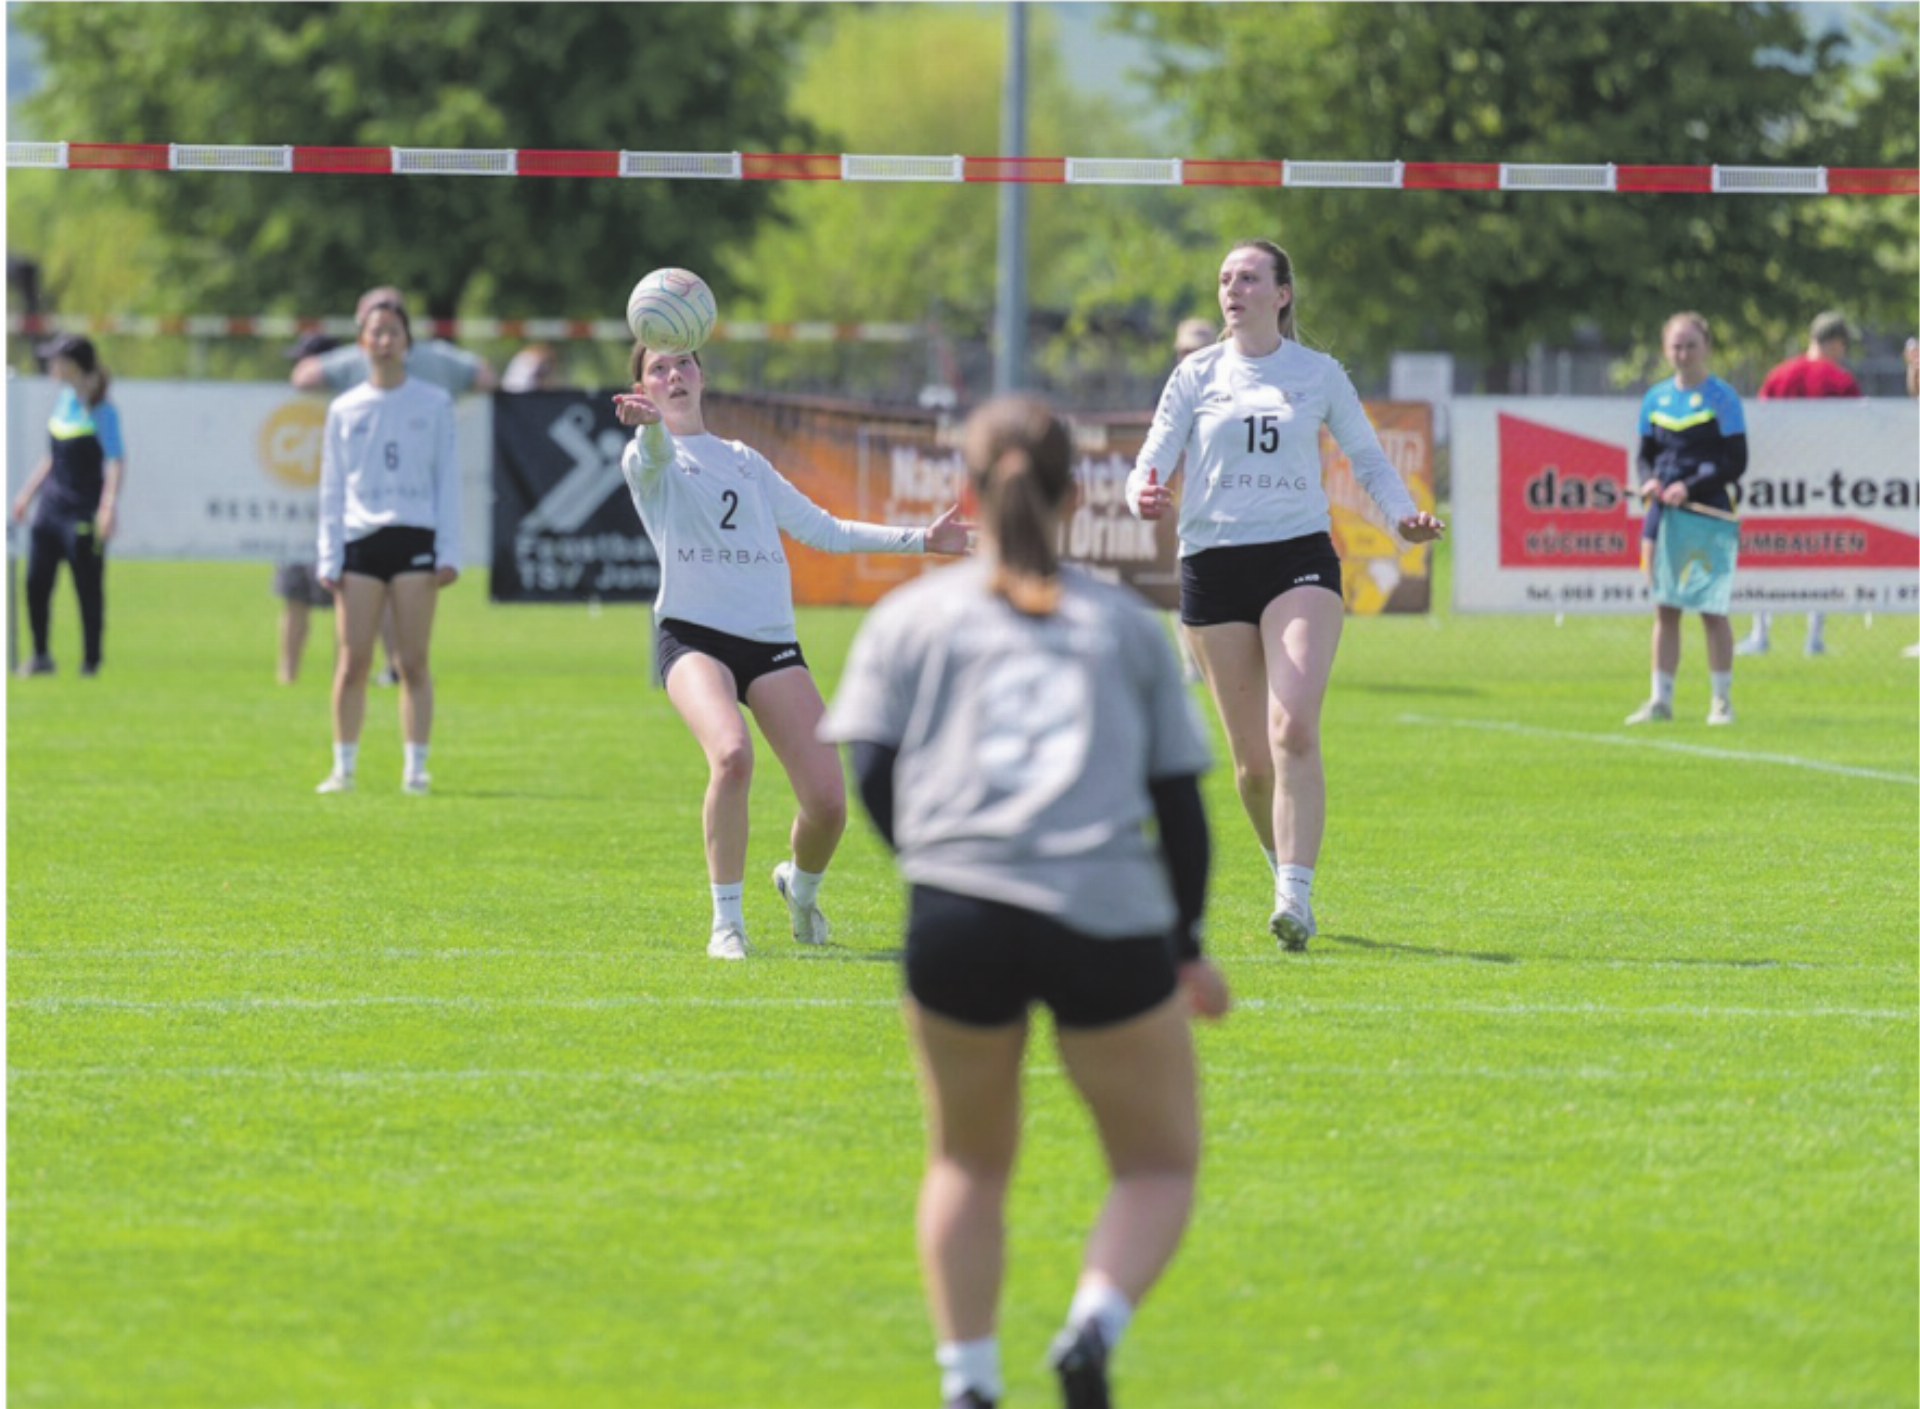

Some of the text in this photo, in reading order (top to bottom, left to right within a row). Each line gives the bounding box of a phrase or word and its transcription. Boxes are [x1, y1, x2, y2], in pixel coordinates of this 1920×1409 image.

[1243, 415, 1280, 454] 15
[385, 442, 399, 471] 6
[206, 498, 319, 522] RESTAU
[720, 489, 738, 530] 2
[678, 548, 785, 564] MERBAG
